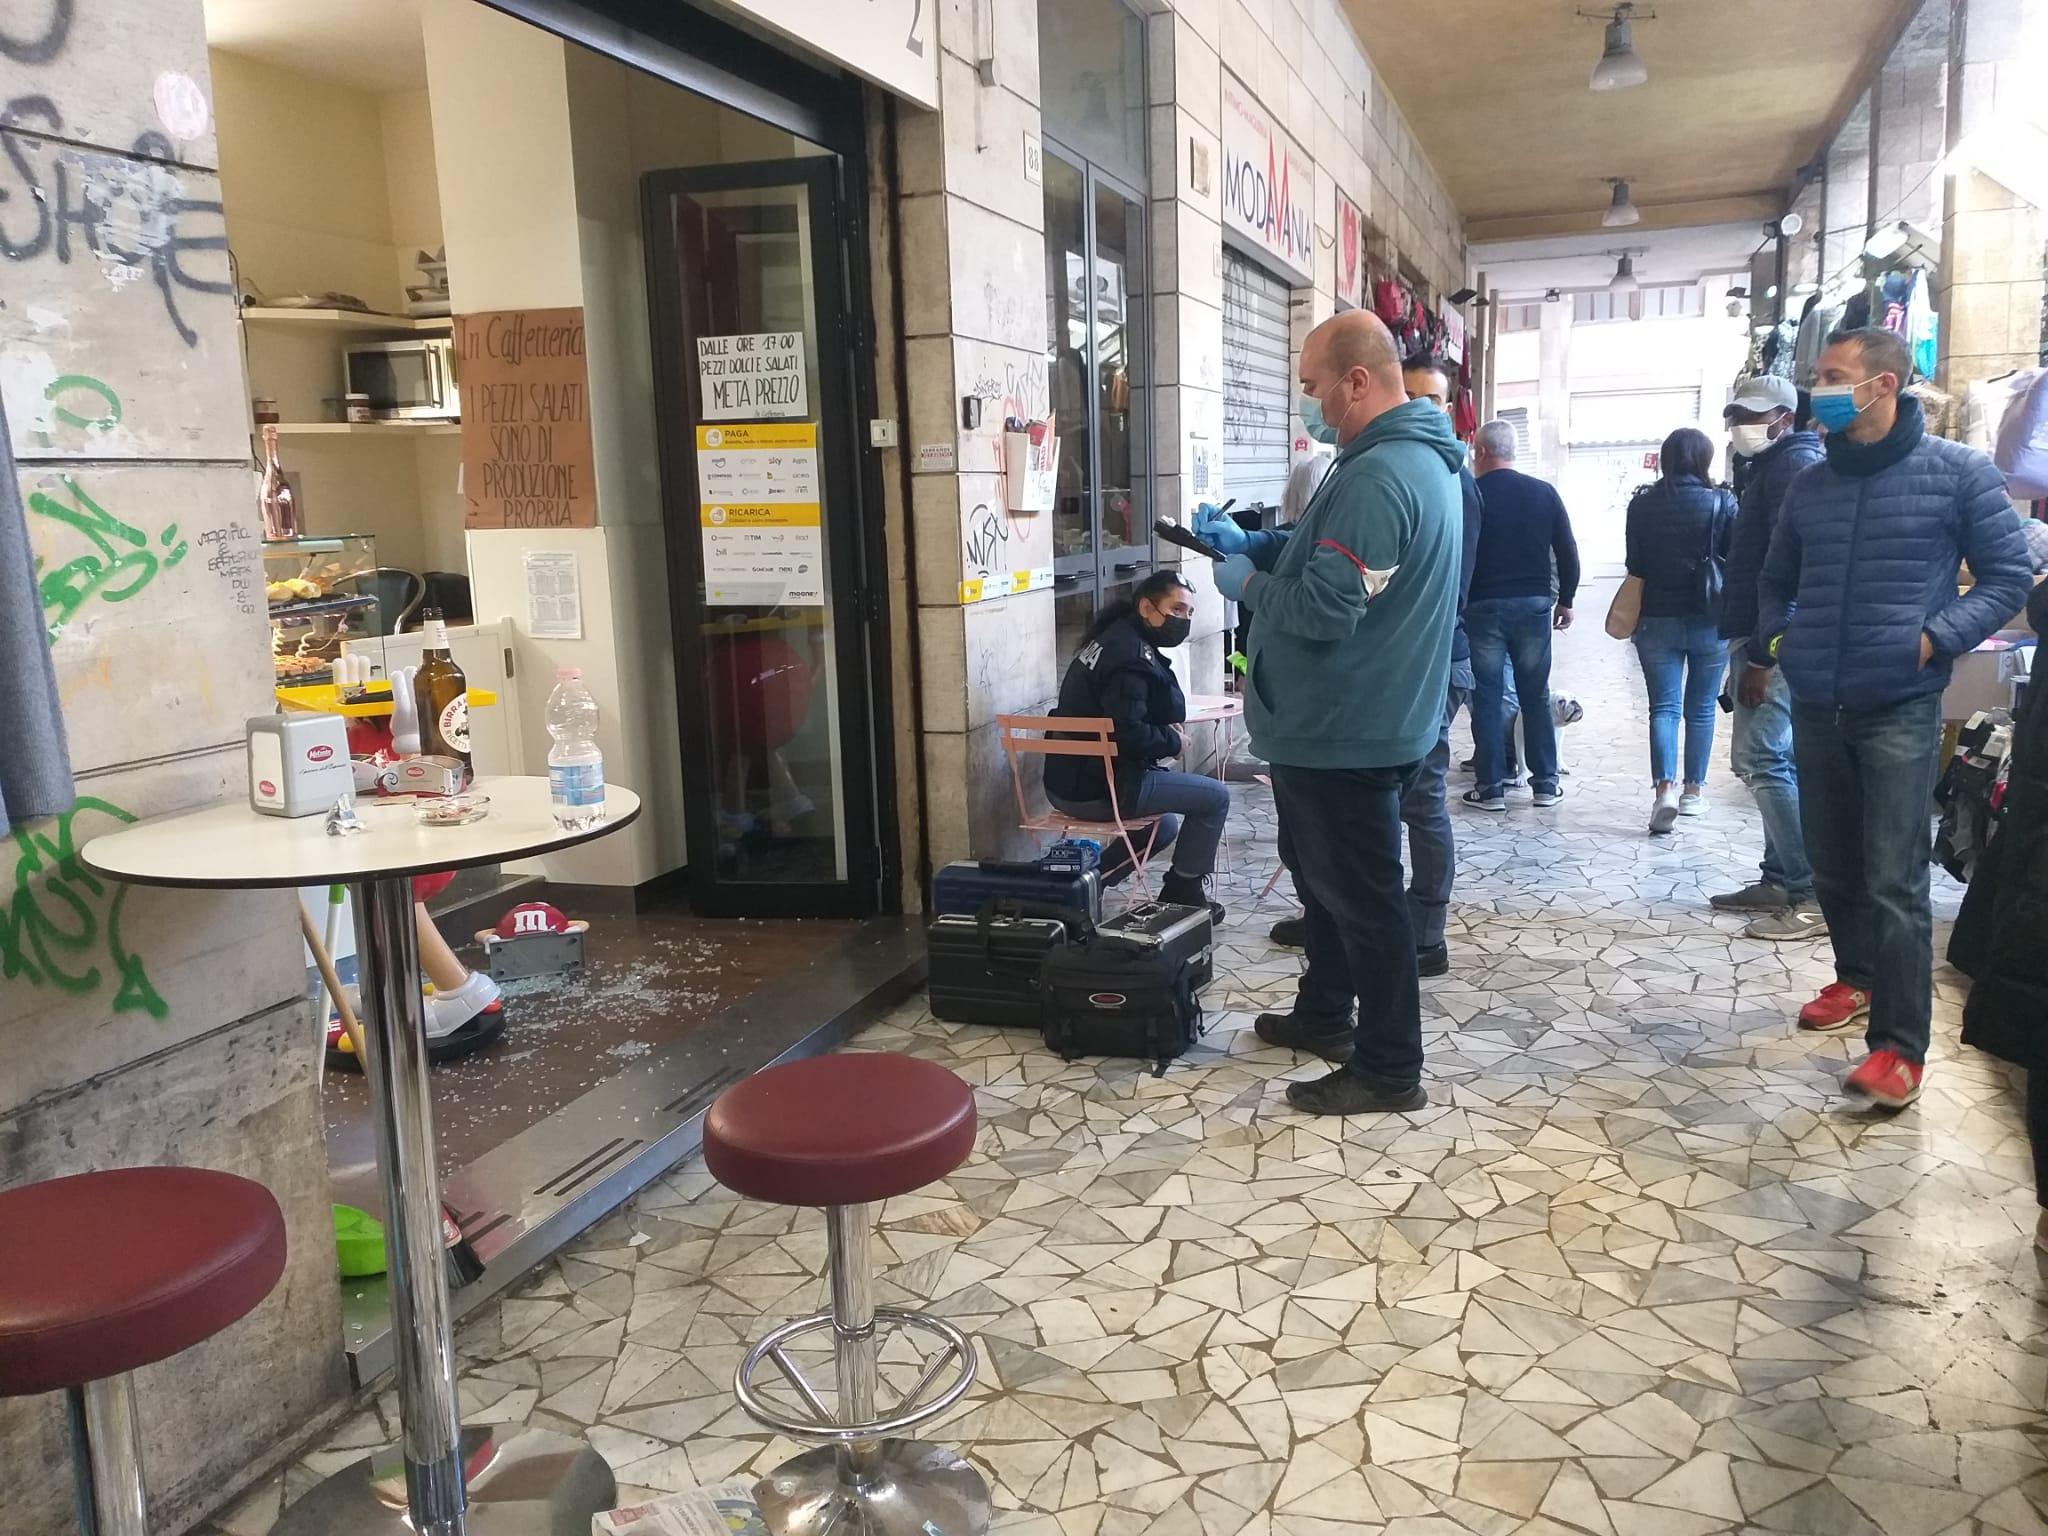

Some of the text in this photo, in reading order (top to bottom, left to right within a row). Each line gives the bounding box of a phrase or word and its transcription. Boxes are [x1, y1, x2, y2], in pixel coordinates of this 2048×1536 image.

[460, 318, 480, 361] In
[700, 338, 729, 357] DALLE
[736, 336, 755, 352] ORE
[762, 335, 777, 350] 17
[701, 355, 798, 376] PEZZI DOLCI E SALATI
[470, 382, 583, 424] I PEZZI SALATI
[755, 374, 800, 405] PREZZO
[491, 425, 553, 463] SONO DI
[724, 430, 749, 438] PAGA
[482, 463, 578, 501] PRODUZIONE
[503, 499, 573, 529] PROPRIA
[728, 508, 771, 517] RICARICA
[443, 700, 463, 728] BIRRA
[514, 909, 548, 933] m
